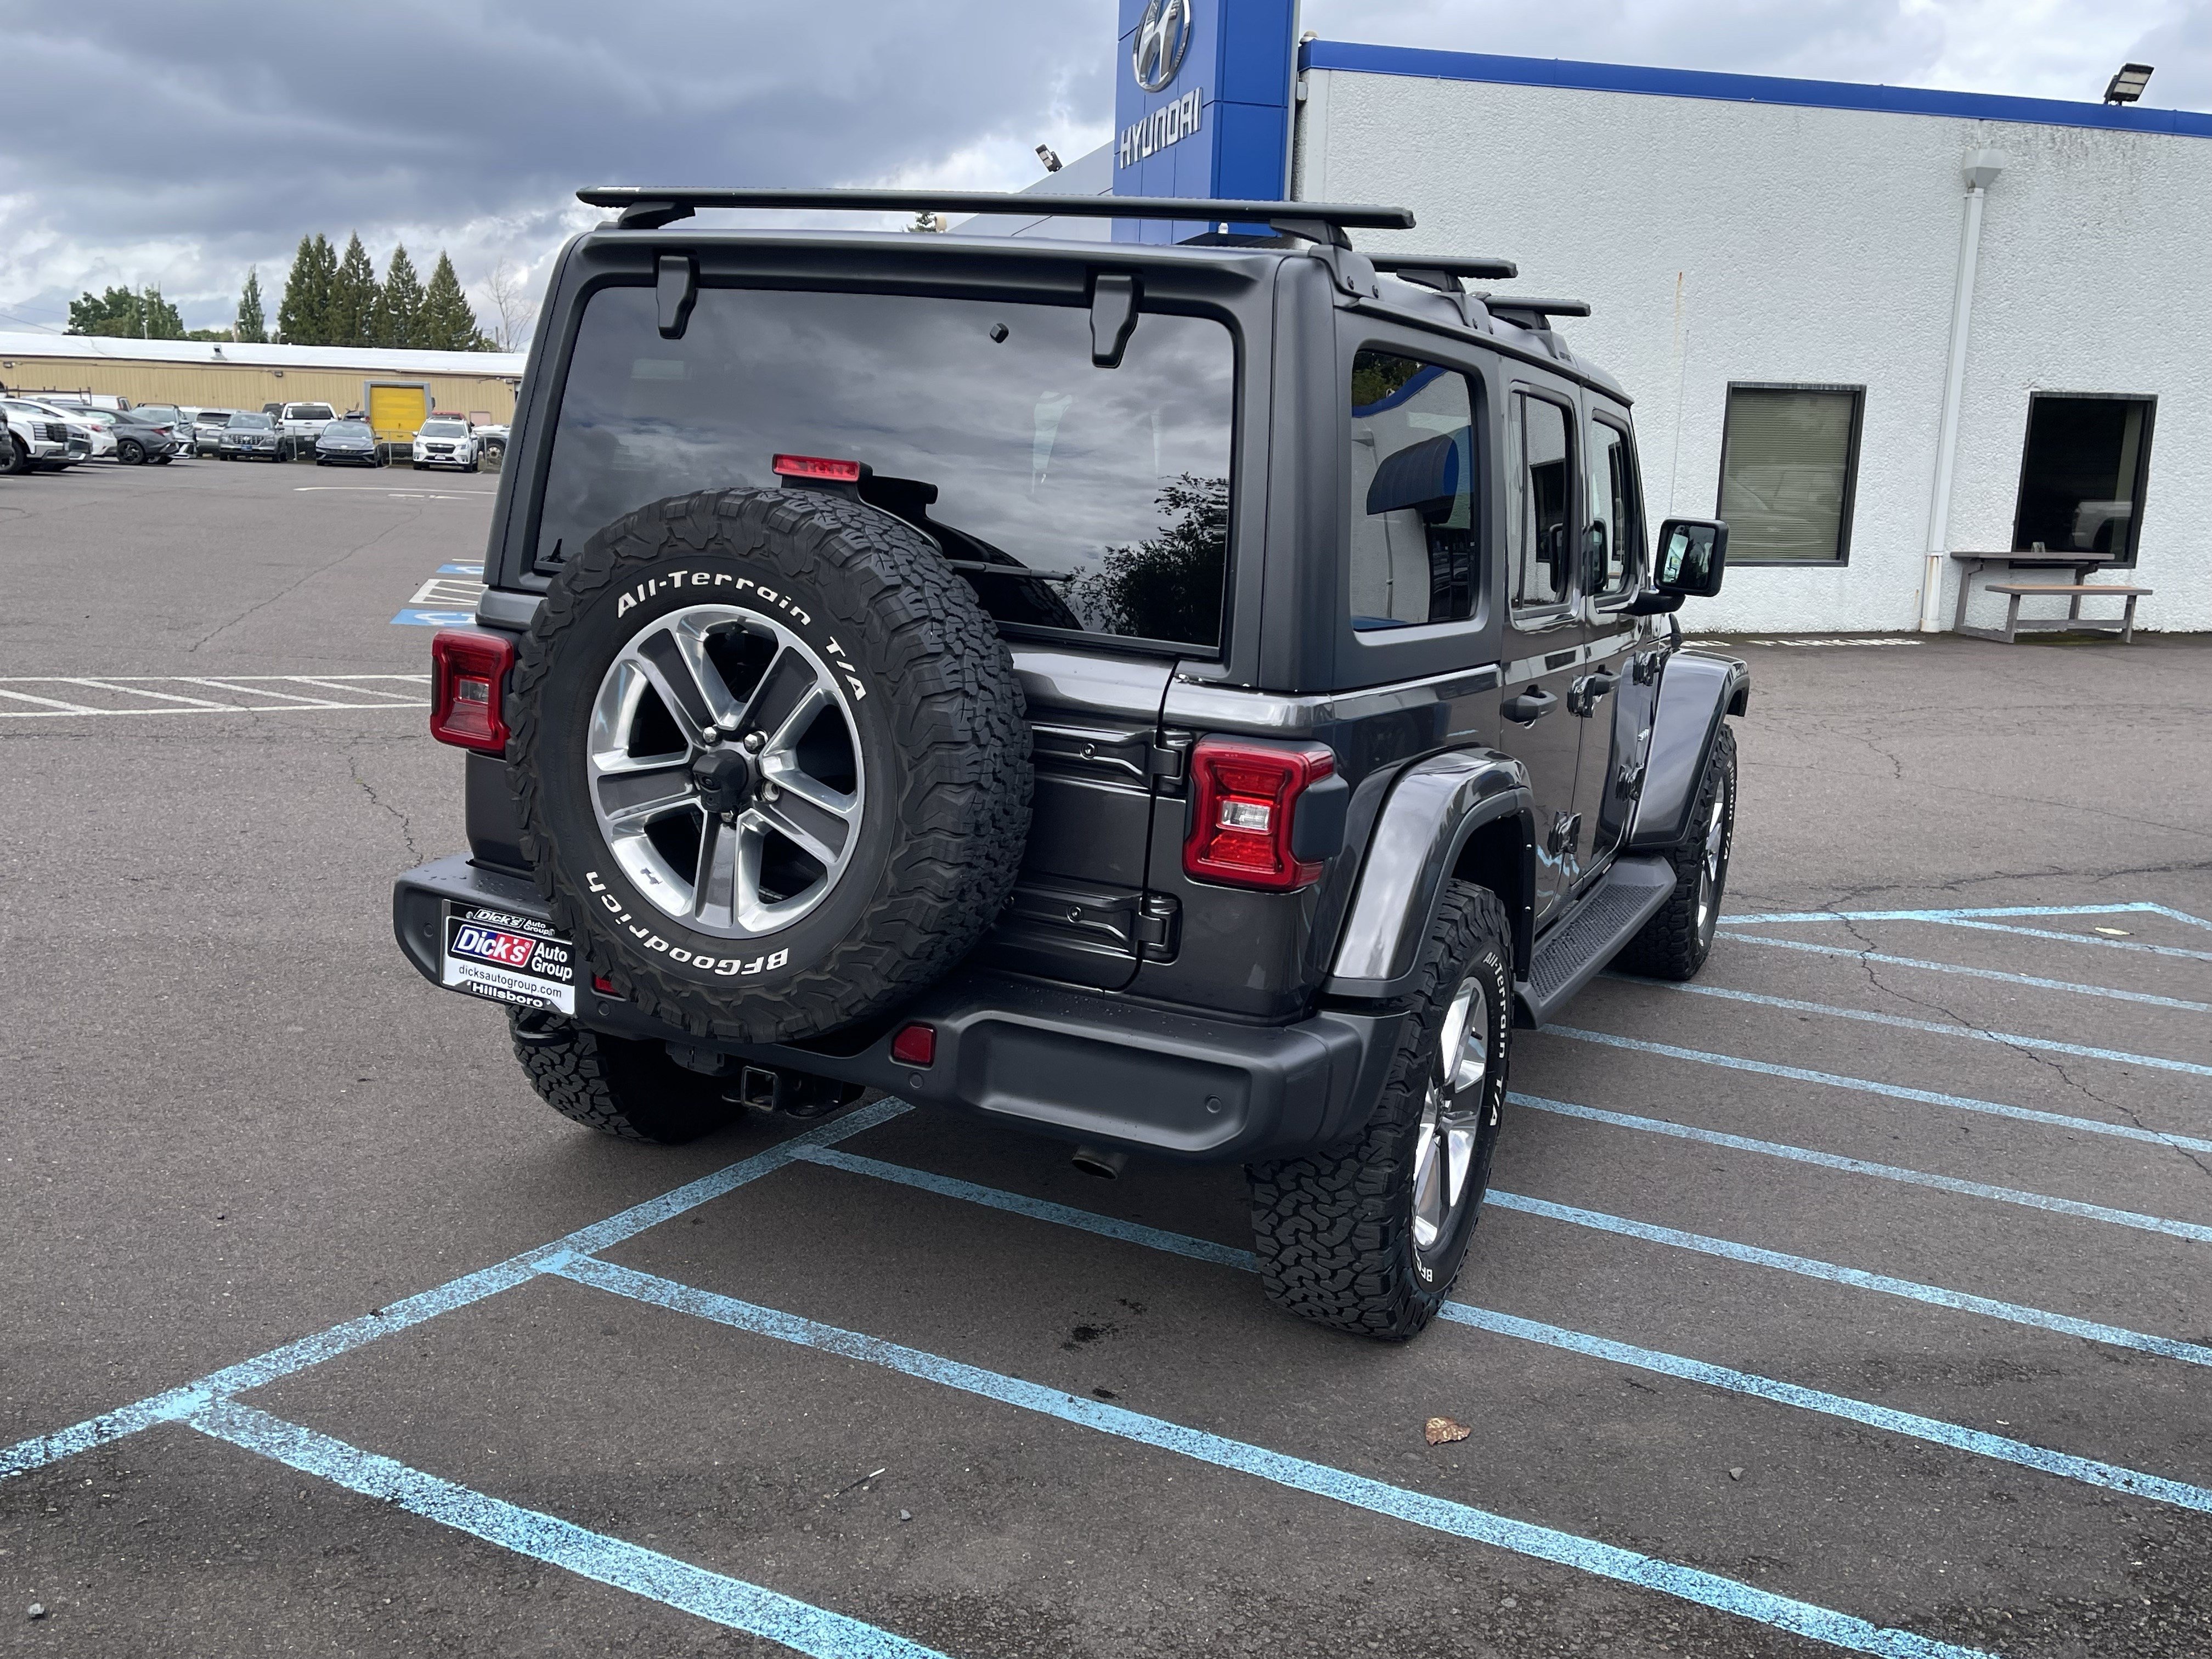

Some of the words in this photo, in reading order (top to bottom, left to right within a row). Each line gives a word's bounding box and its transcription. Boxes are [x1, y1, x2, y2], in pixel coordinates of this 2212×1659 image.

[1120, 86, 1203, 169] HYUNDAI
[616, 569, 811, 627] All-Terrain
[825, 636, 867, 701] T/A
[1746, 638, 1925, 647] PARKING
[476, 911, 521, 927] Dick's
[523, 924, 550, 936] Group
[526, 919, 546, 929] Auto
[585, 871, 790, 977] BFGoodrich
[534, 942, 568, 963] Auto
[459, 965, 562, 998] dicksautogroup.com
[531, 957, 572, 981] Group
[472, 983, 544, 1008] Hillsboro
[1482, 952, 1506, 1059] All-Terrain
[1489, 1075, 1503, 1126] T/A
